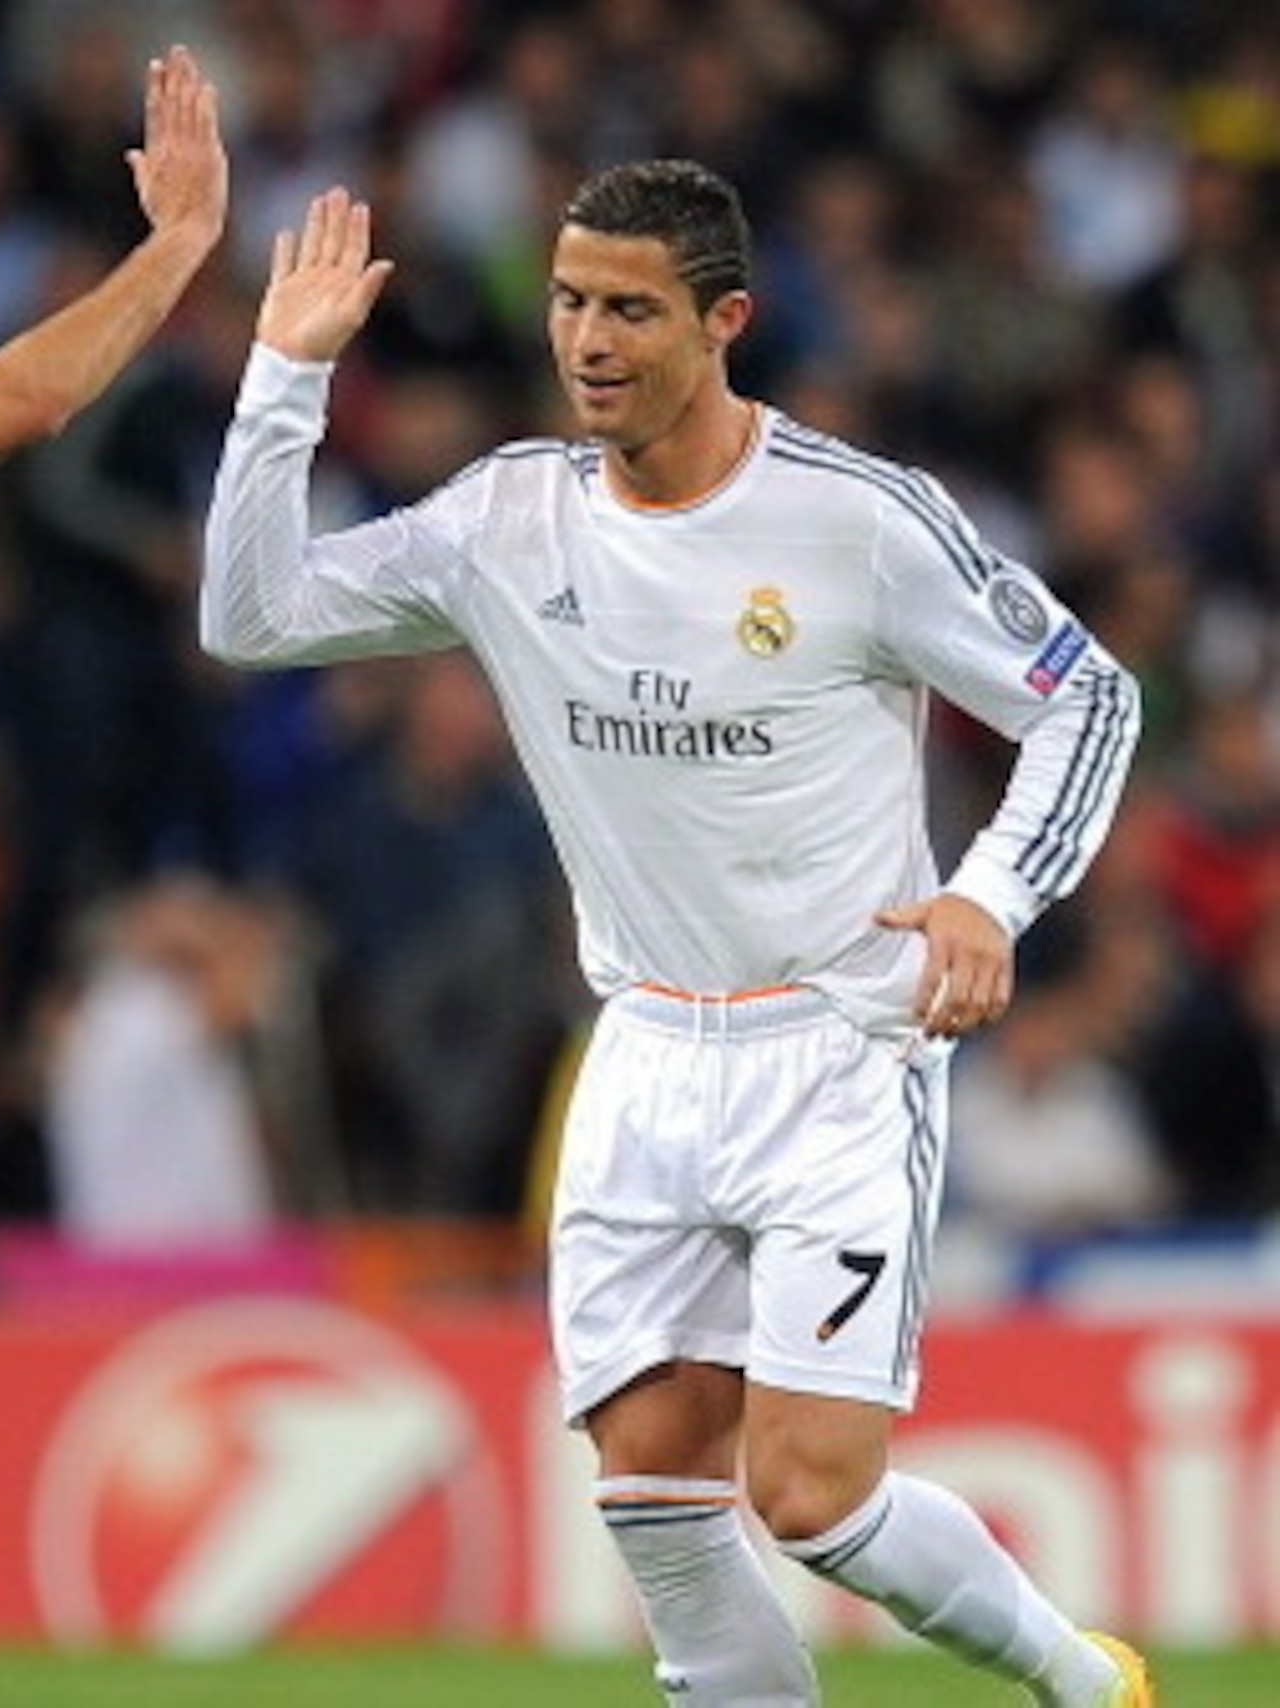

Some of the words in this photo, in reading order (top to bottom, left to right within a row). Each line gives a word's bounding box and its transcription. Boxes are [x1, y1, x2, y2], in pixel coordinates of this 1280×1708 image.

[630, 669, 692, 710] Fly
[565, 700, 774, 758] Emirates
[816, 1249, 887, 1343] 7
